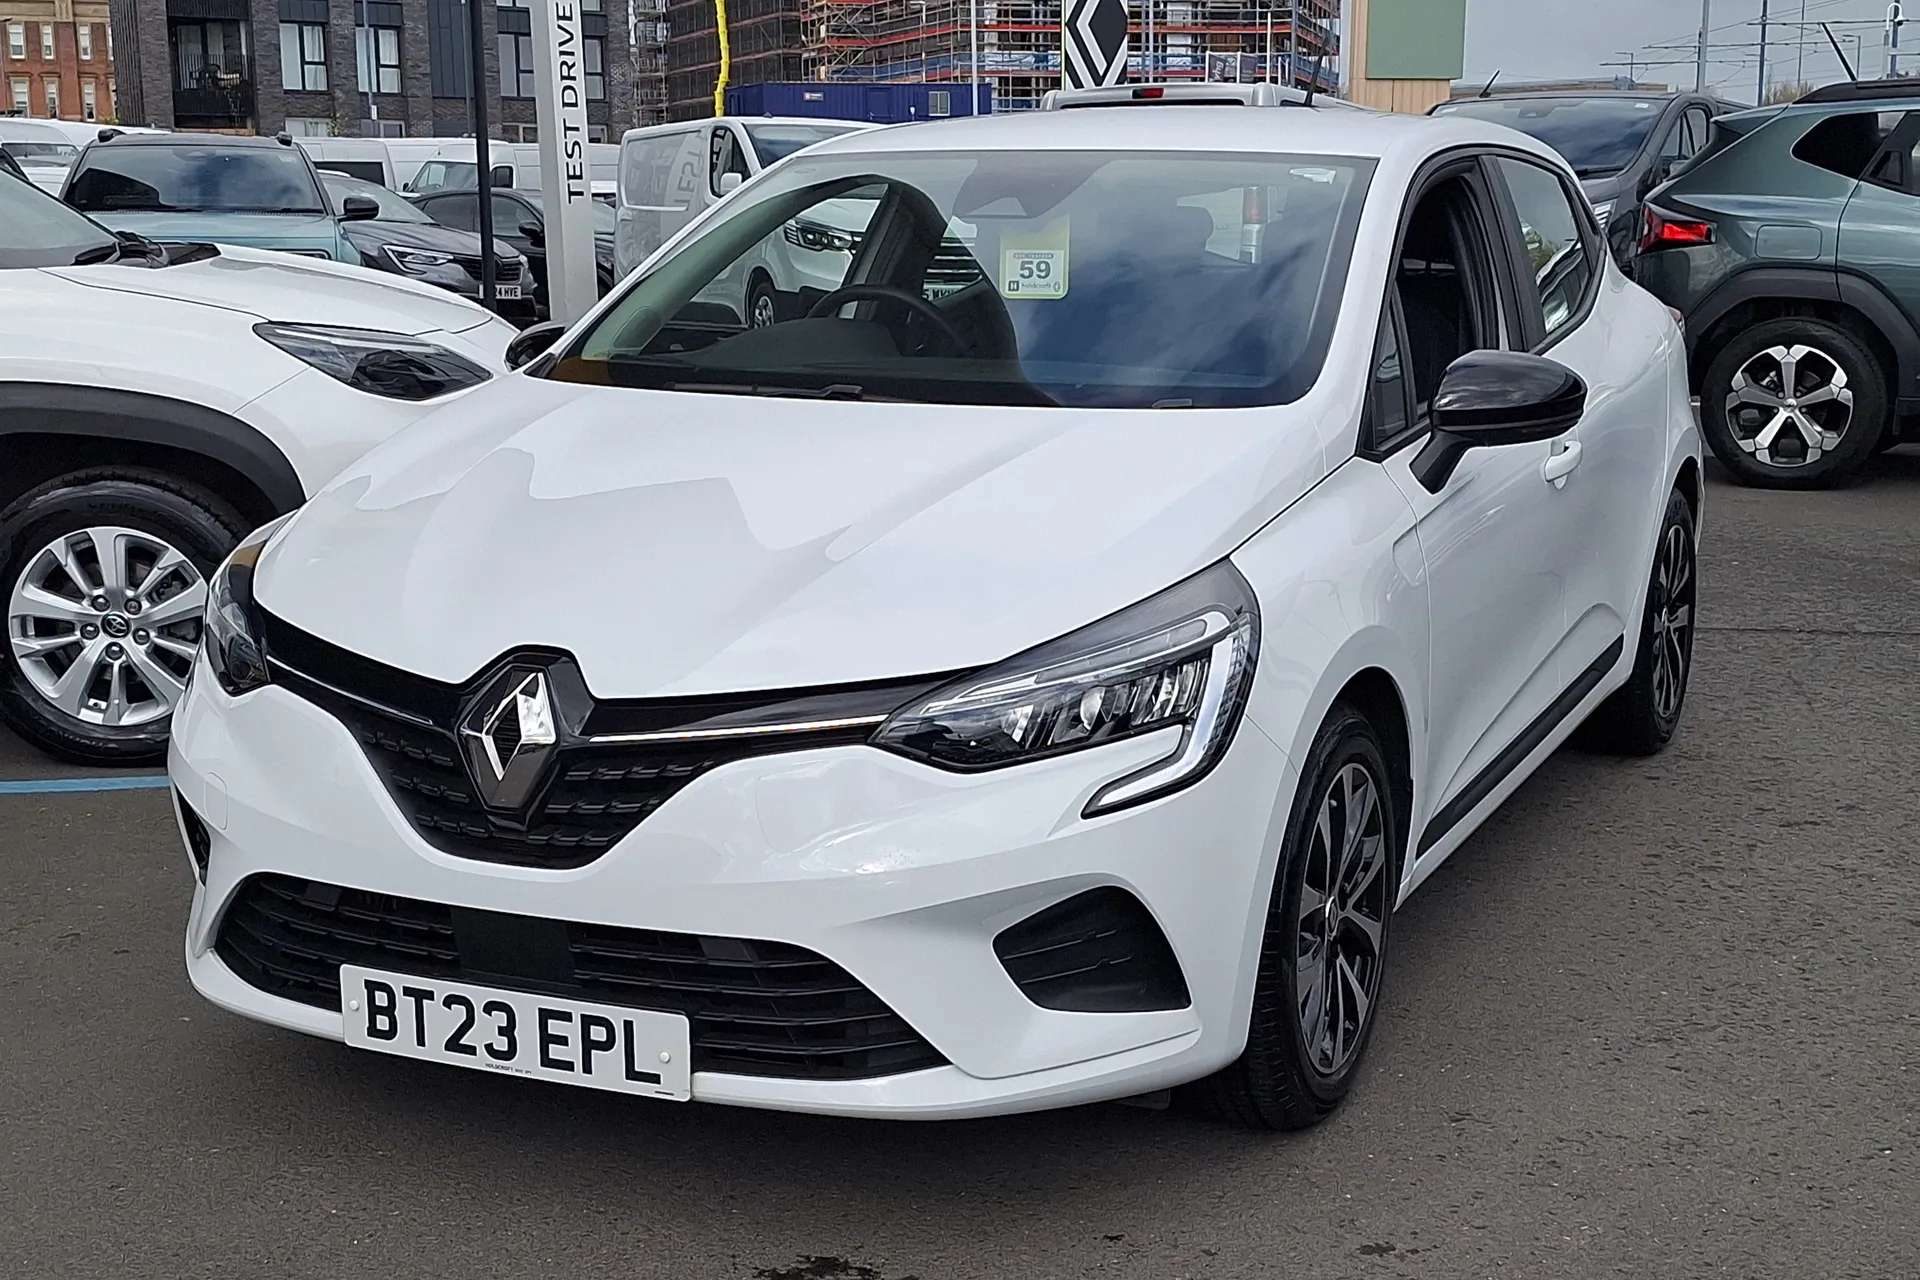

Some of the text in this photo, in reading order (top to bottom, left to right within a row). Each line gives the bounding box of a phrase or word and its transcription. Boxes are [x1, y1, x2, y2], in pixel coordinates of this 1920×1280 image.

[556, 2, 584, 204] TEST DRIVE
[1019, 260, 1051, 279] 59
[363, 979, 662, 1085] BT23 EPL
